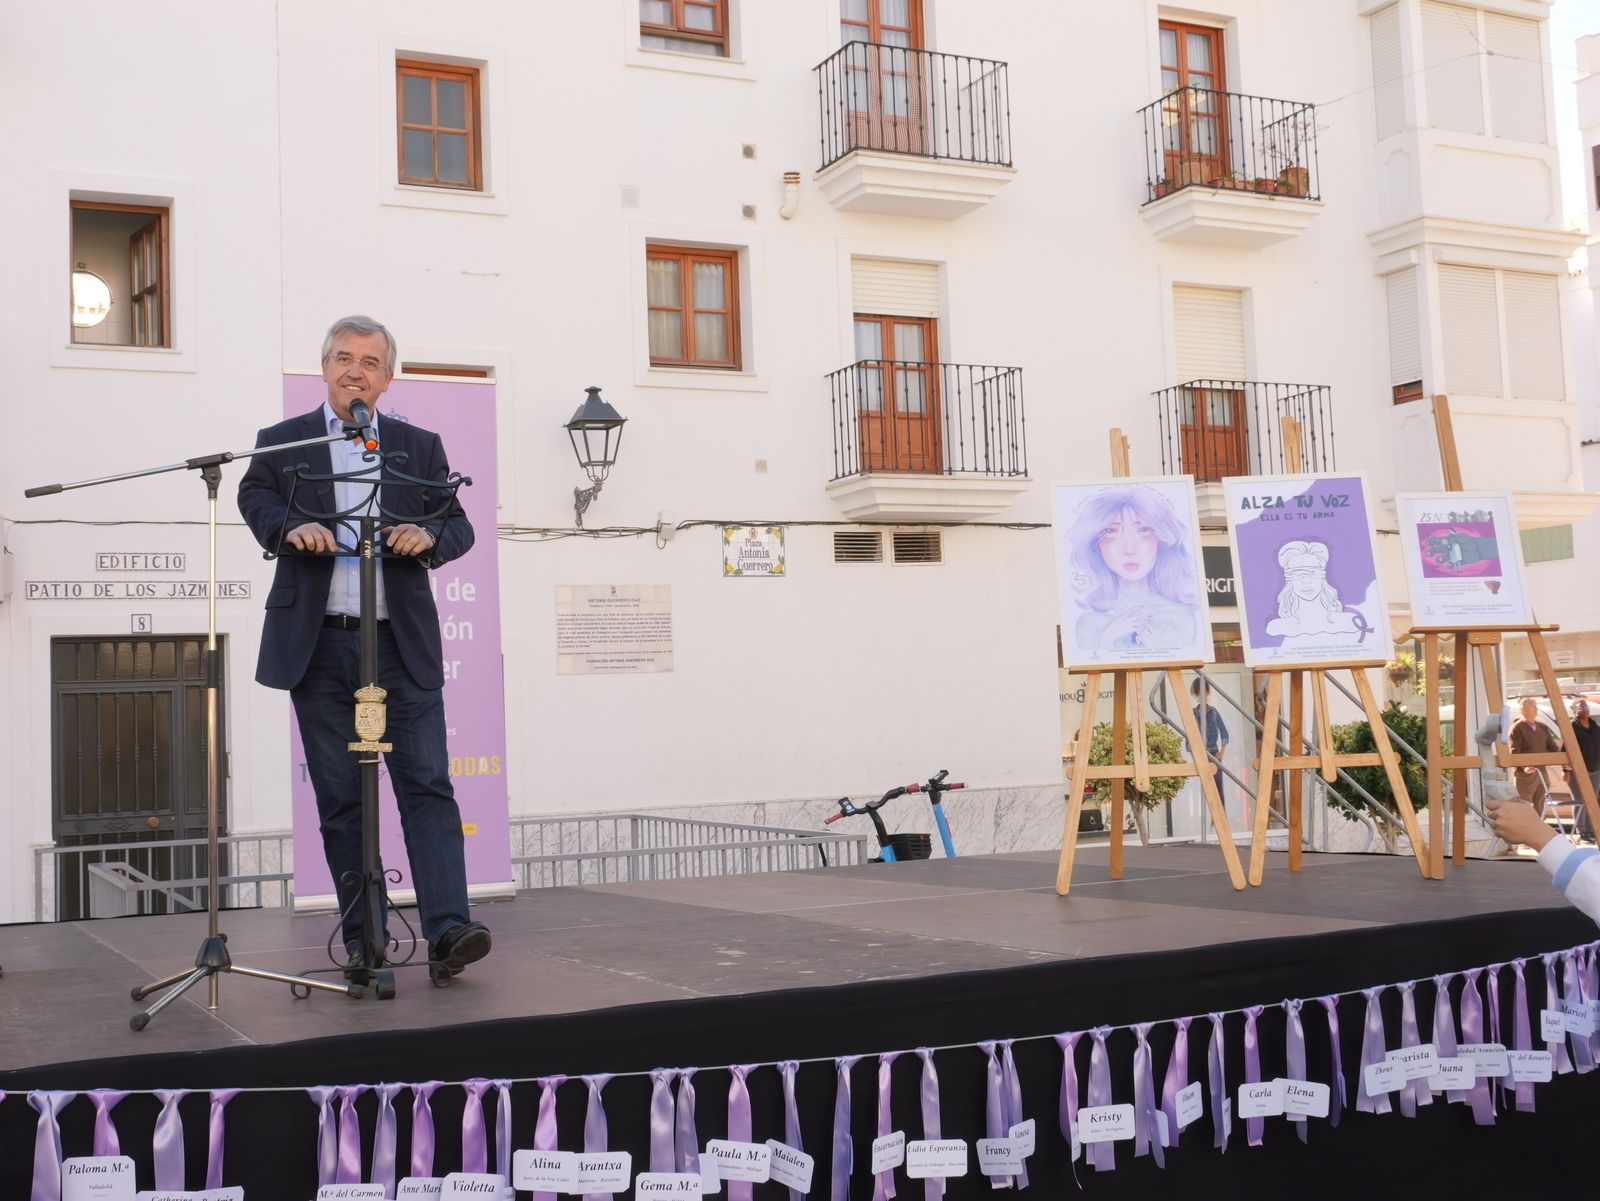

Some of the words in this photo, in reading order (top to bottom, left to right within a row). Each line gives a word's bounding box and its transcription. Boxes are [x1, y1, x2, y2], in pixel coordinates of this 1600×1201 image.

[1241, 496, 1285, 509] ALZA
[1293, 495, 1314, 508] TU
[1320, 494, 1350, 508] VOZ
[745, 538, 763, 547] Plaza
[738, 546, 770, 559] Antonia
[99, 555, 183, 569] EDIFICIO
[737, 558, 773, 571] Guerrero
[29, 584, 83, 597] PATIO
[94, 584, 114, 597] DE
[126, 584, 156, 597] LOS
[167, 583, 248, 597] JAZMNES
[446, 577, 476, 602] de
[138, 617, 146, 630] 8
[440, 615, 474, 641] ón
[450, 756, 502, 777] ODAS
[1560, 1005, 1588, 1019] Maricel
[1438, 1063, 1464, 1074] Juana
[1249, 1088, 1272, 1099] Carla
[1287, 1085, 1314, 1097] Elena
[1090, 1112, 1122, 1124] Kristy
[711, 1146, 742, 1160] Paula
[929, 1144, 966, 1153] Esperanza
[985, 1145, 1011, 1157] Francy
[529, 1157, 562, 1170] Alina
[773, 1148, 806, 1168] Maialen
[68, 1164, 107, 1175] Paloma
[577, 1161, 622, 1172] Arantxa
[401, 1185, 420, 1194] Anne
[452, 1180, 496, 1193] Violetta
[640, 1180, 673, 1191] Gema
[336, 1189, 348, 1198] del
